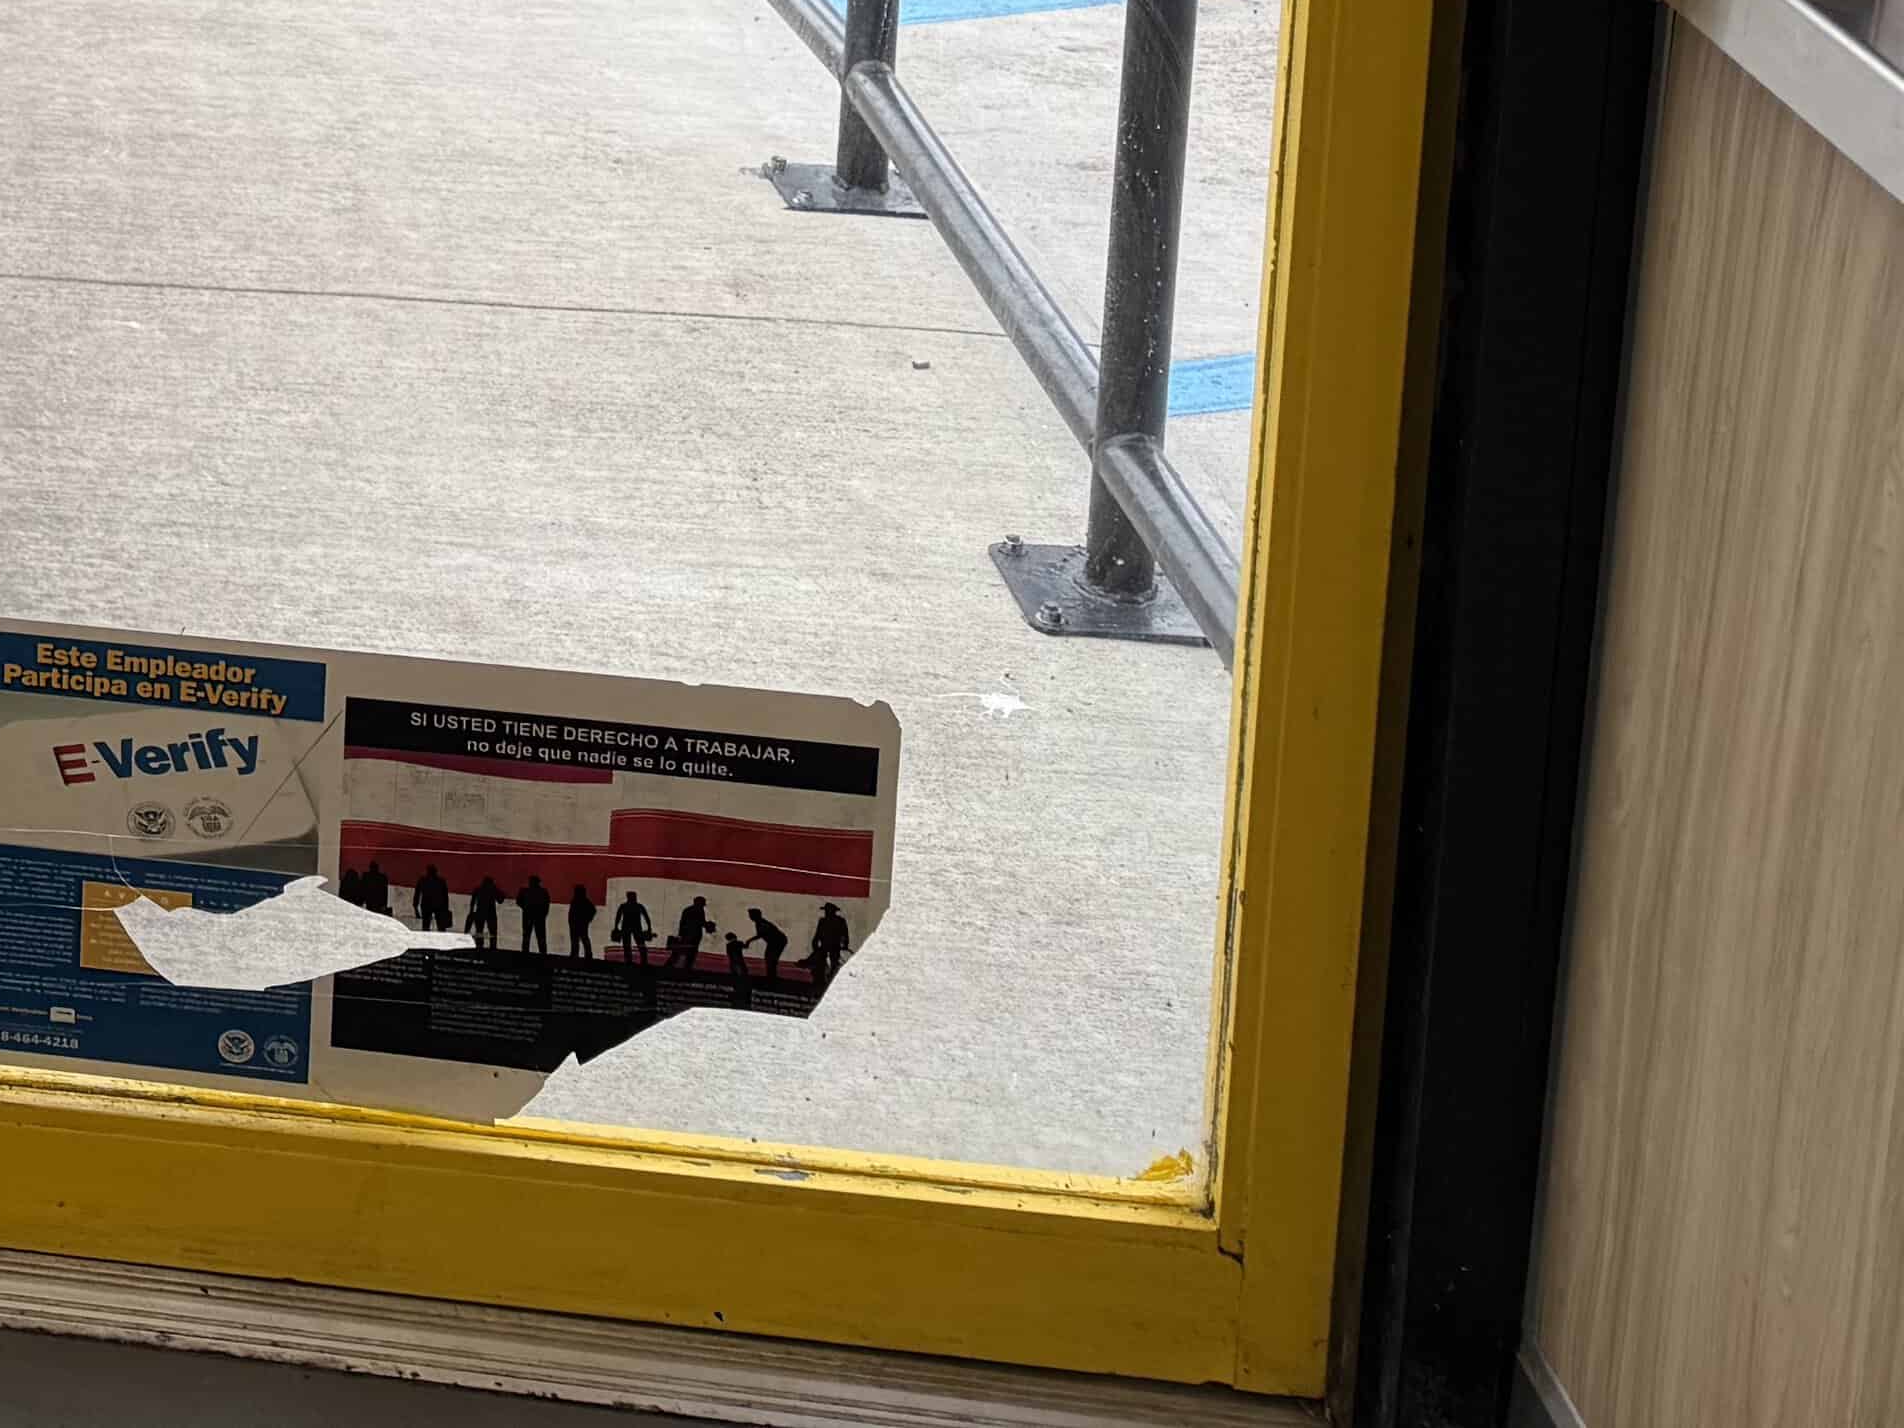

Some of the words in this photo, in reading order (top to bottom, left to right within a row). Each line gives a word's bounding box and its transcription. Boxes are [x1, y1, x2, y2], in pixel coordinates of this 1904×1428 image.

[37, 642, 98, 669] Este
[106, 648, 257, 684] Empleador
[3, 663, 128, 698] Participa
[136, 679, 171, 701] en
[179, 680, 288, 715] E-Verify
[410, 711, 429, 728] SI
[432, 713, 497, 734] USTED
[501, 719, 558, 740] TIENE
[563, 725, 659, 750] DERECHO
[664, 736, 678, 751] A
[52, 728, 260, 787] E-Verify
[466, 739, 489, 753] no
[495, 738, 533, 761] deje
[537, 745, 572, 764] que
[577, 747, 624, 766] nadie
[632, 756, 654, 769] se
[659, 754, 677, 770] lo
[682, 757, 735, 778] quite.
